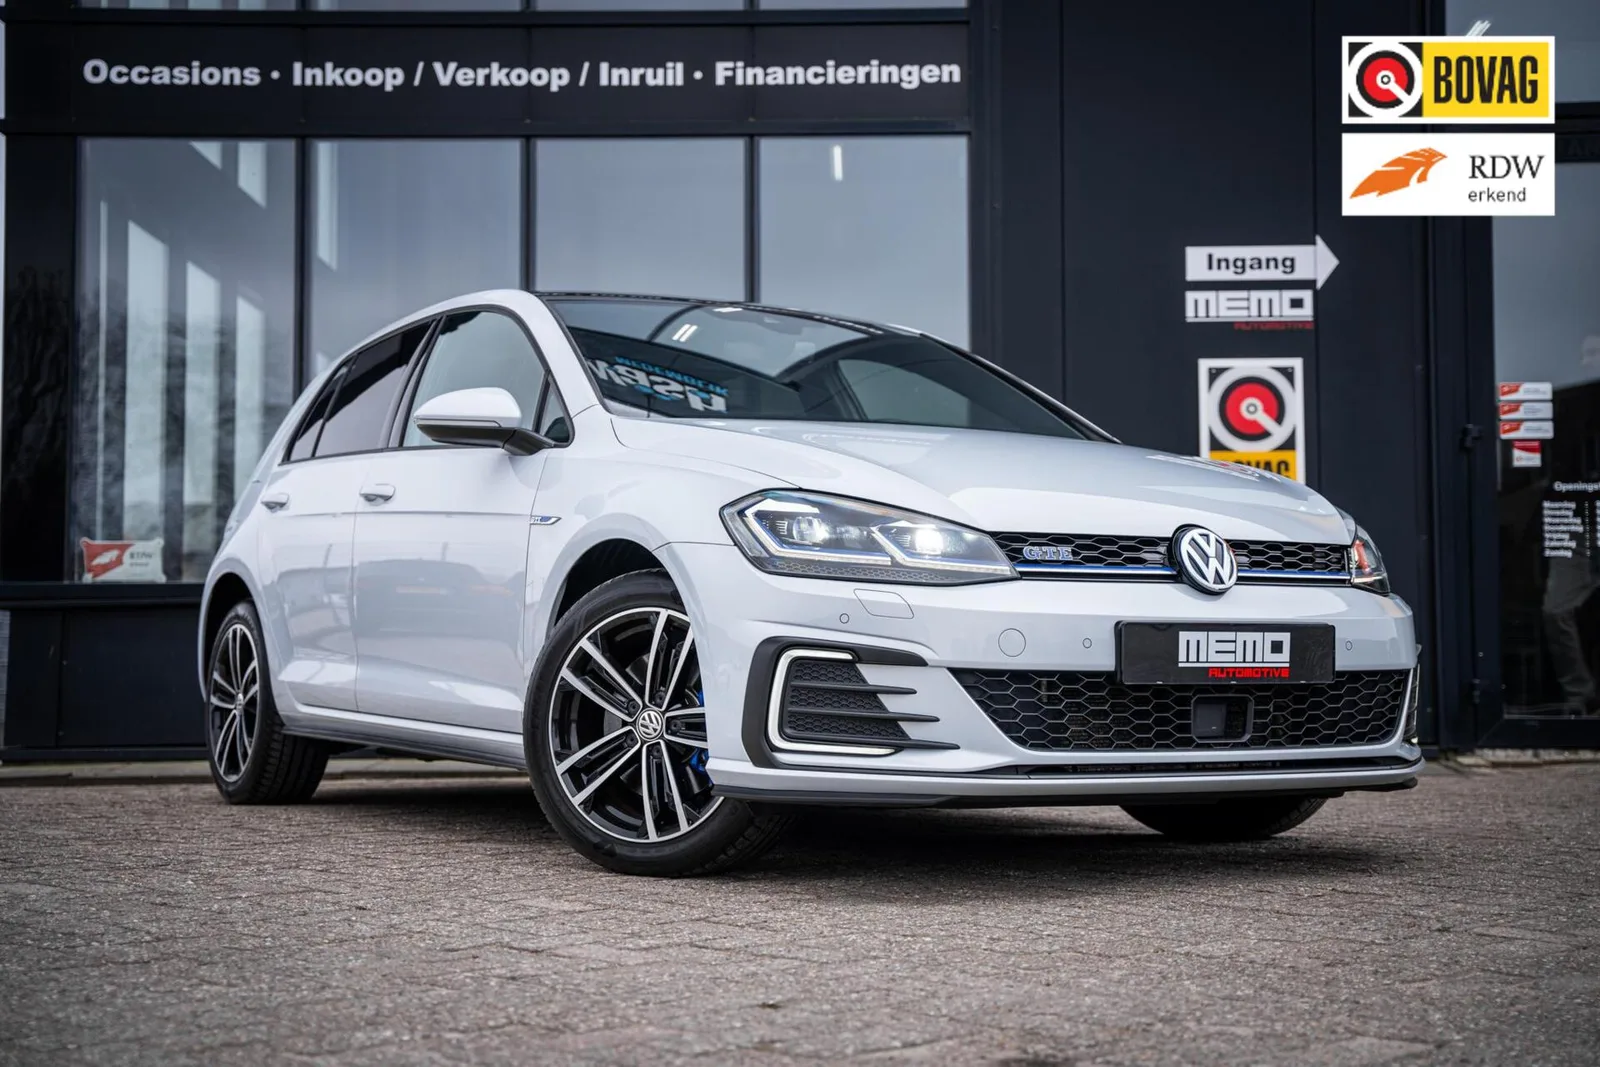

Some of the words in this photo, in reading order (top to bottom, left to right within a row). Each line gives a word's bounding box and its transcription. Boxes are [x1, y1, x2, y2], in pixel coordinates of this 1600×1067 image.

[83, 58, 261, 86] Occasions
[292, 61, 404, 92] Inkoop
[432, 61, 570, 92] Verkoop
[599, 61, 685, 87] Inruil
[714, 59, 961, 90] Financieringen
[1207, 252, 1296, 275] Ingang
[1185, 290, 1314, 318] MEMO
[1022, 545, 1073, 560] GTE
[1178, 631, 1291, 662] MEMO
[1208, 667, 1290, 678] AUTOMOTIVE
